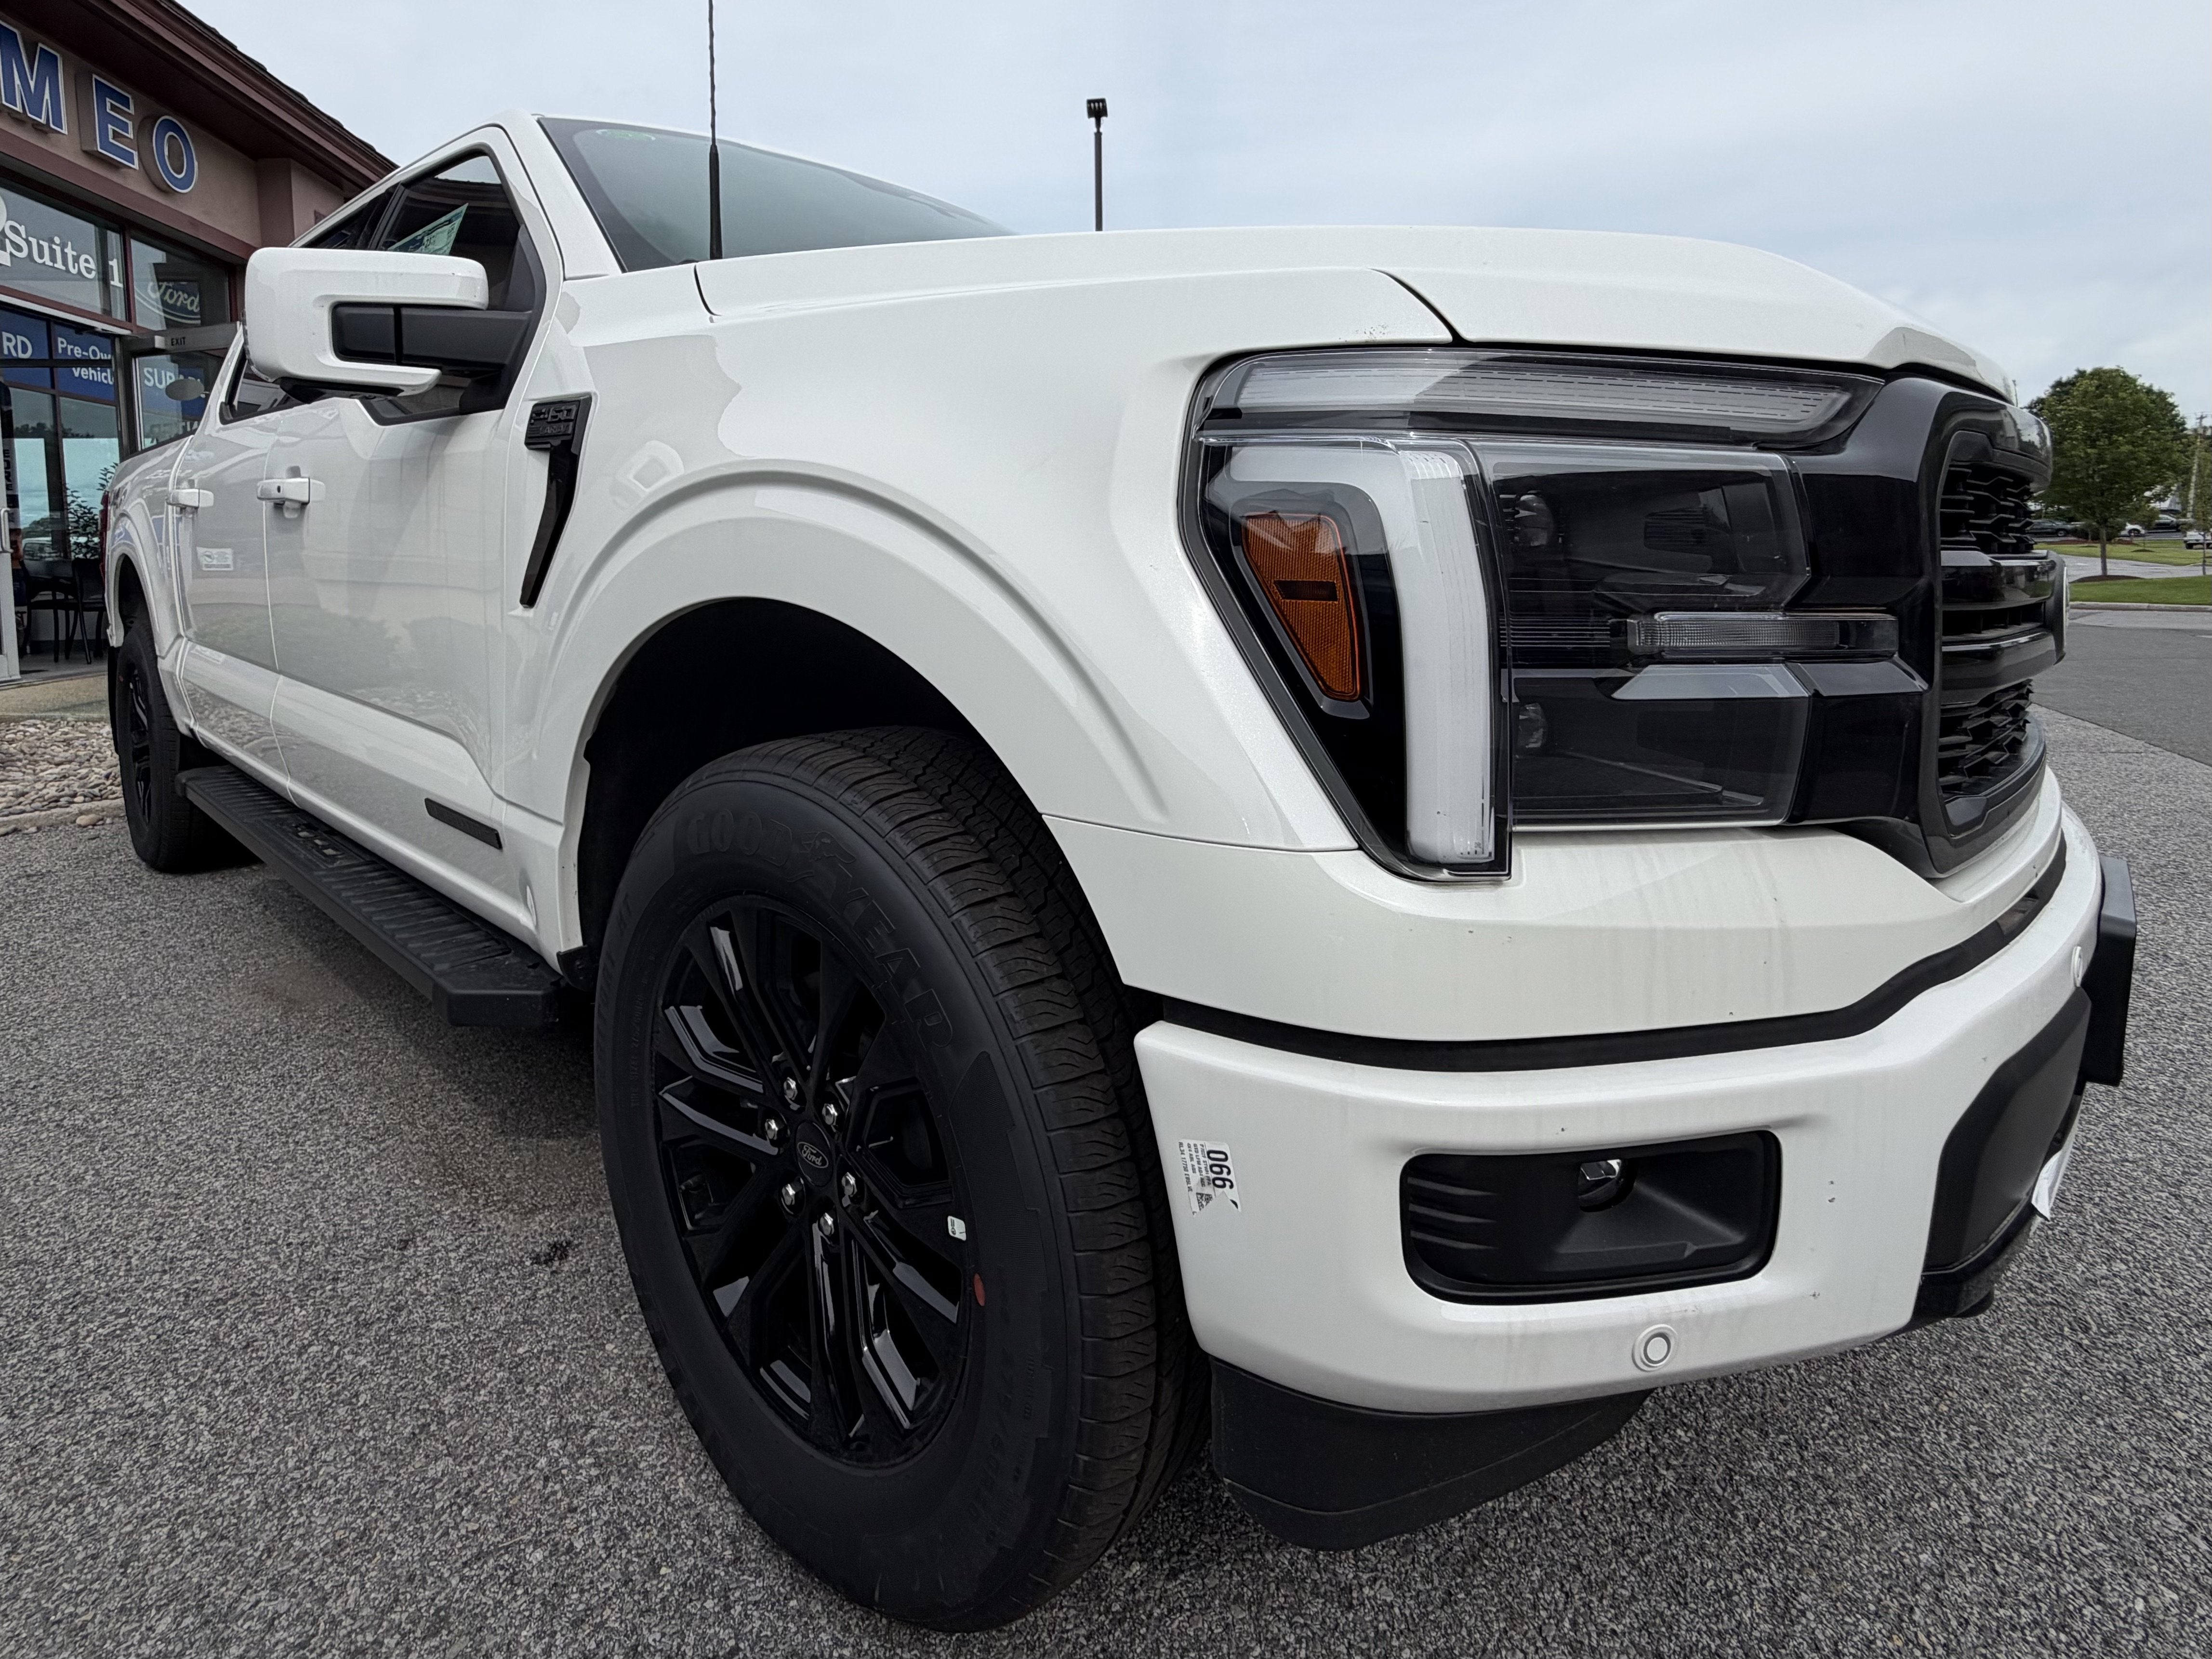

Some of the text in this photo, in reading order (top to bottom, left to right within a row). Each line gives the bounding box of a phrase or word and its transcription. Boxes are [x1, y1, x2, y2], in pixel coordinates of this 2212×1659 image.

[4, 220, 96, 279] Suite
[108, 258, 123, 288] 1
[171, 337, 185, 346] EXIT
[801, 1144, 823, 1167] Ford
[1206, 1150, 1234, 1190] 066
